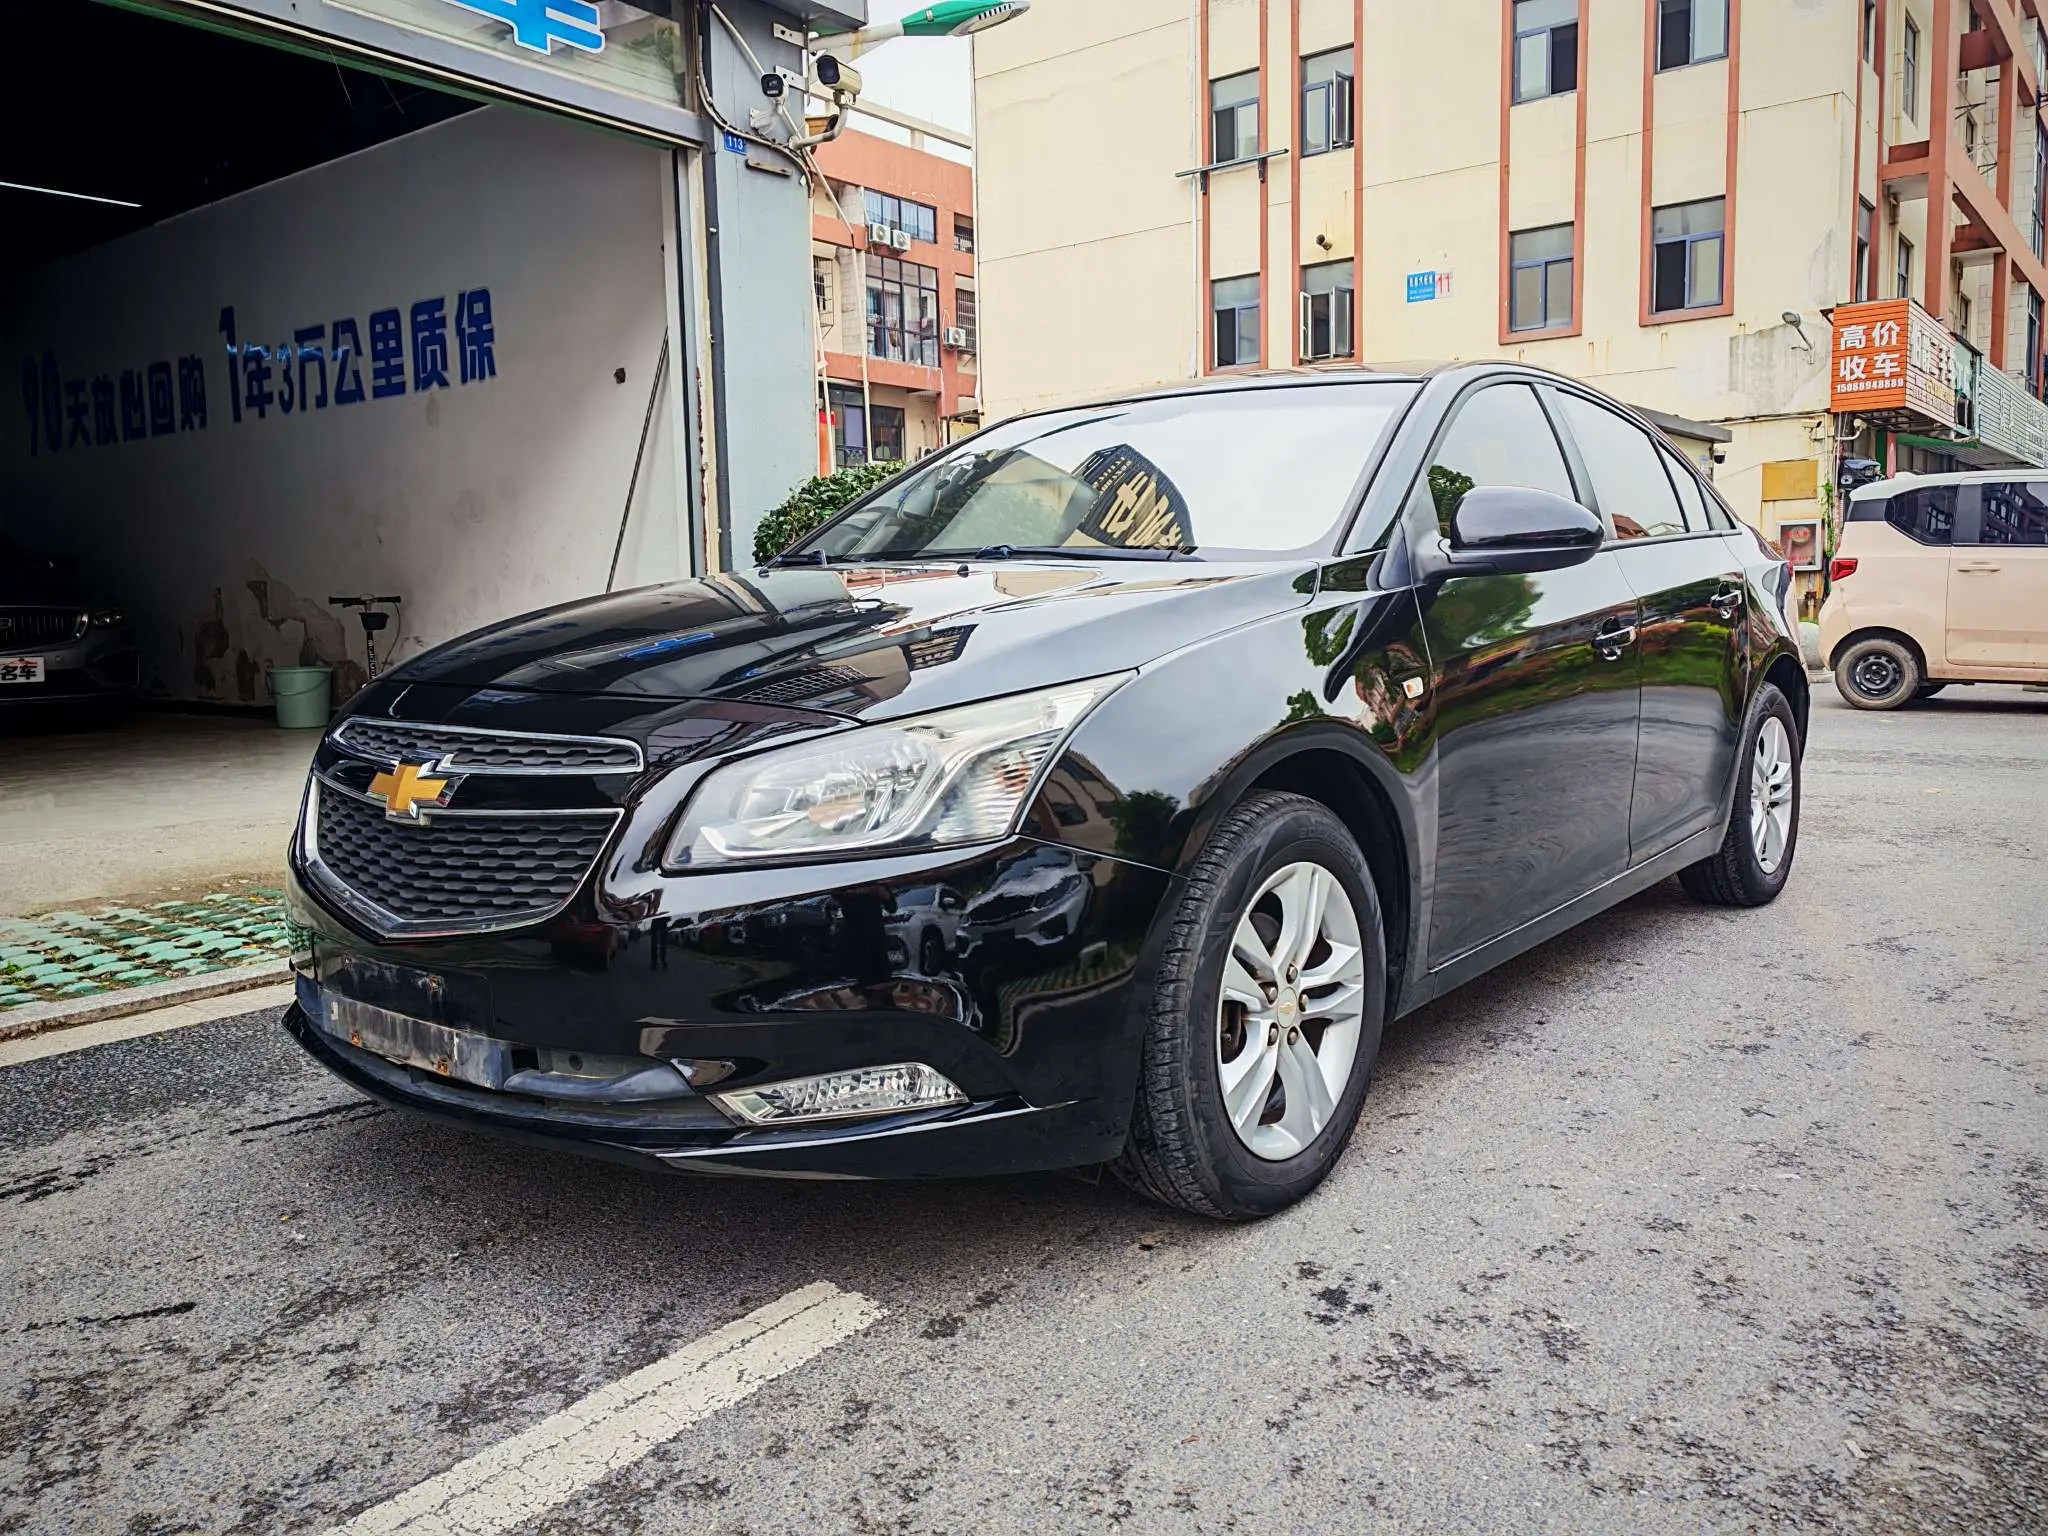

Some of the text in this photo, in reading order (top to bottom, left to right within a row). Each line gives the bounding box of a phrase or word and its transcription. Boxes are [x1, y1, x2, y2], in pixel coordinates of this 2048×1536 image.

[728, 136, 743, 149] 113
[1839, 320, 1901, 351] 高价
[21, 287, 497, 457] 90天放心回购 1年3万公里质保
[1839, 351, 1901, 382] 收车
[0, 664, 38, 681] 名车
